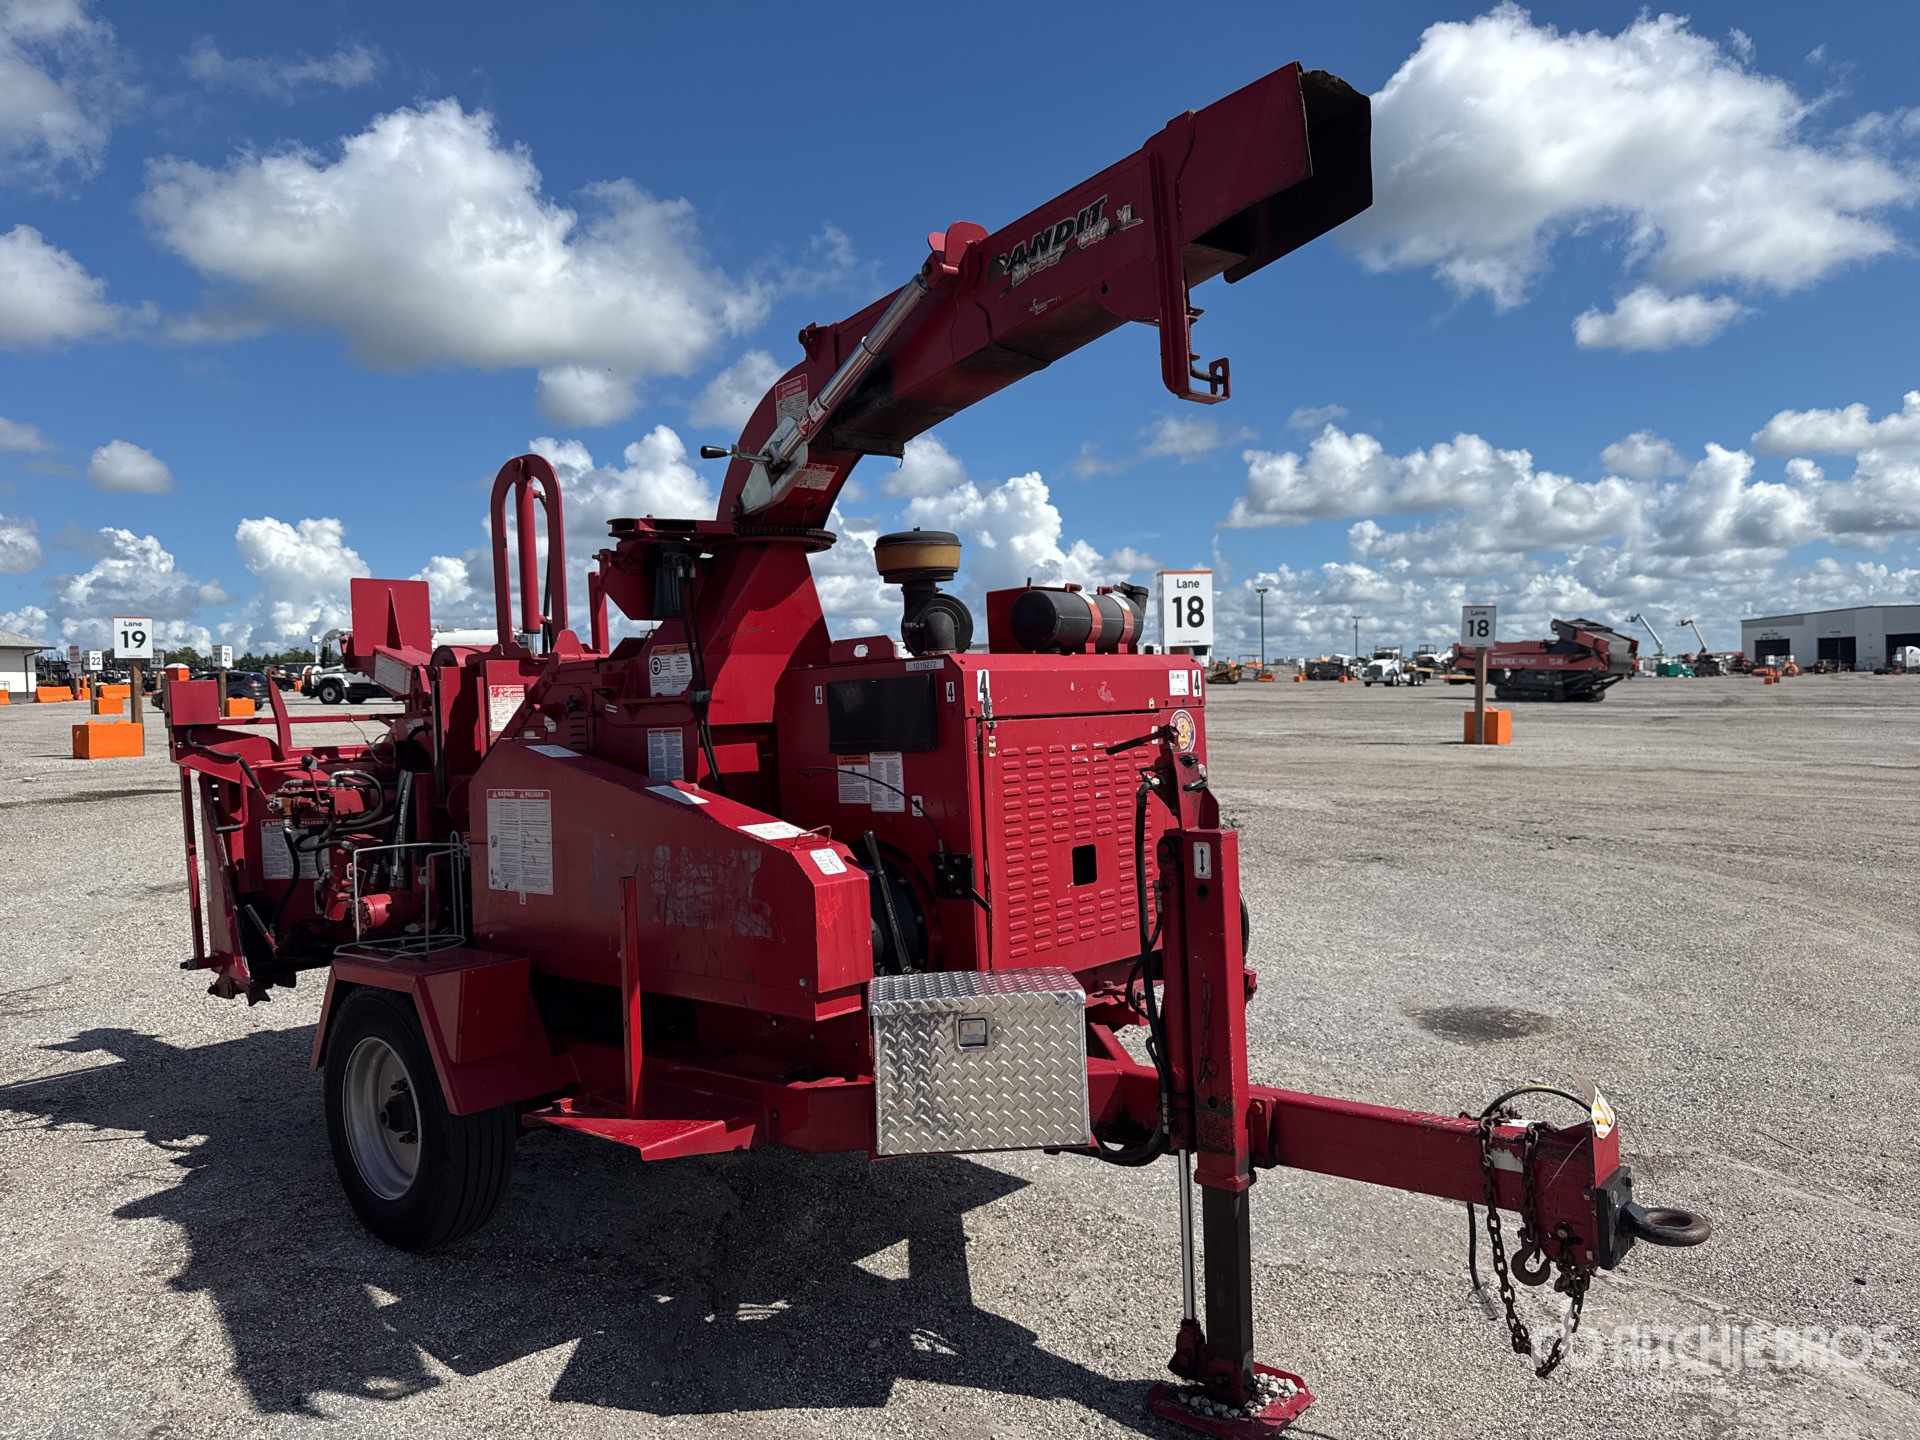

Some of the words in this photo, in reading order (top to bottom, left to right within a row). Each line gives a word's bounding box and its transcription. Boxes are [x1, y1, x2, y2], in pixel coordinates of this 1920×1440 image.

[1176, 579, 1200, 589] Lane
[1172, 595, 1205, 628] 18
[1467, 619, 1490, 637] 18
[120, 630, 146, 649] 19
[91, 656, 101, 665] 22
[151, 657, 161, 665] 23
[224, 652, 231, 661] 21
[912, 660, 937, 670] 1019272
[947, 682, 954, 700] 4
[979, 670, 988, 698] 4
[1194, 670, 1201, 695] 4
[816, 686, 822, 703] 4
